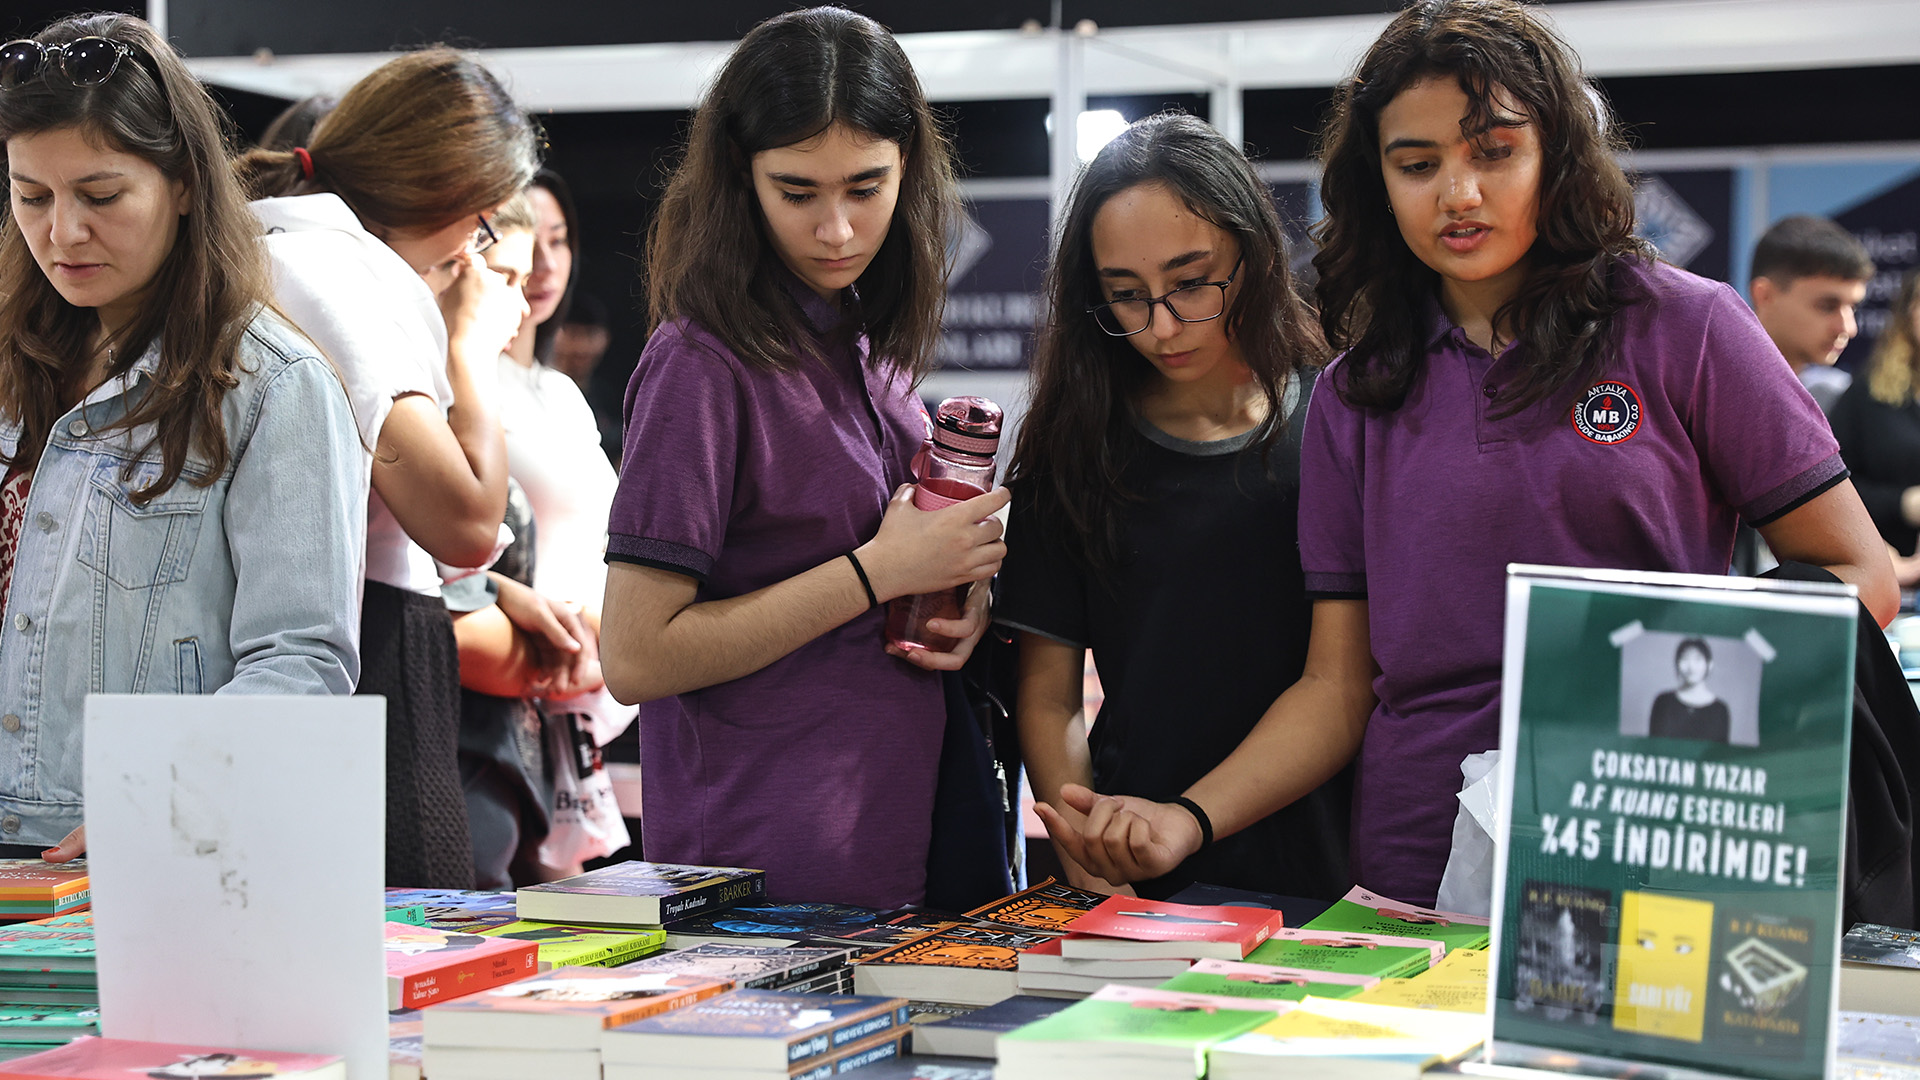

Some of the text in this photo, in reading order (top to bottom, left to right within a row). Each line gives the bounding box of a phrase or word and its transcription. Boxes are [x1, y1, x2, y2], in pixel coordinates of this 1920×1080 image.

[1587, 384, 1627, 397] ANTALYA
[1574, 402, 1595, 438] MECDUDE
[1592, 410, 1620, 424] MB
[1703, 762, 1766, 796] YAZAR
[1570, 782, 1785, 834] R.F KUANG ESERLERİ
[1540, 814, 1808, 888] %45 İNDİRİMDE!
[724, 881, 752, 902] BARKER
